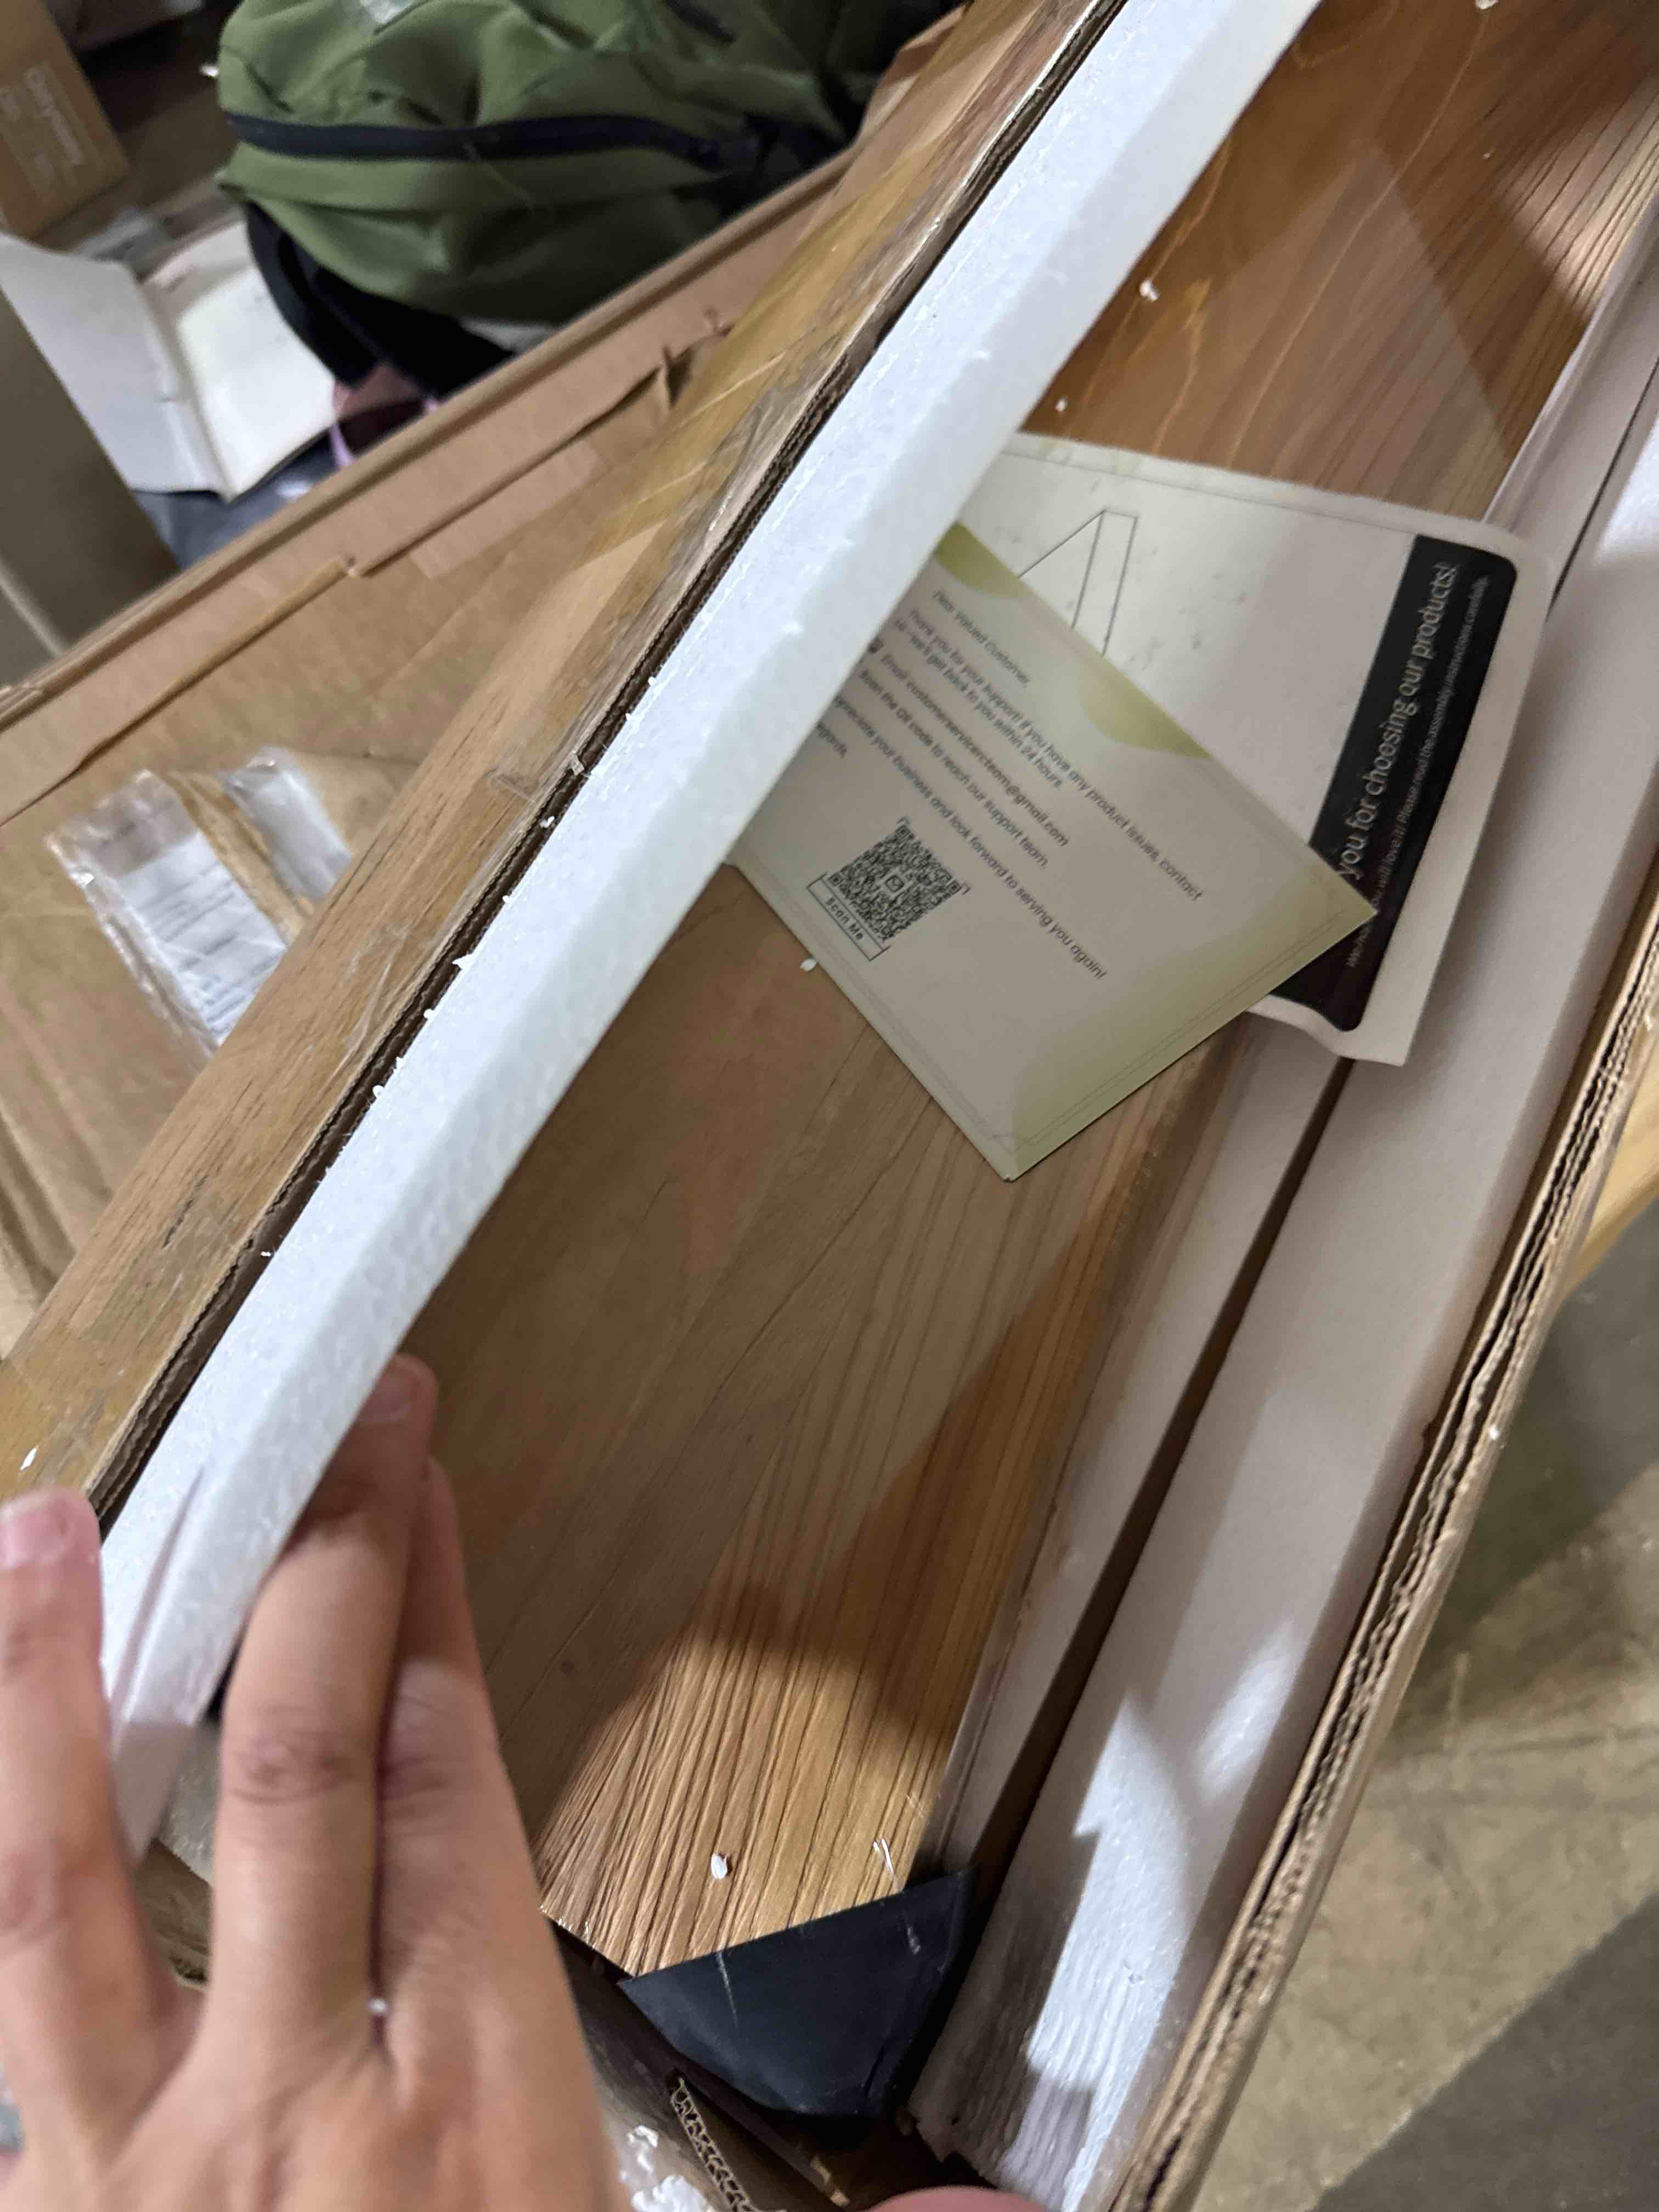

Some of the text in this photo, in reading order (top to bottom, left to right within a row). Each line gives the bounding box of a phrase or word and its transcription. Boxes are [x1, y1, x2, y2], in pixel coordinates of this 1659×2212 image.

[932, 589, 1035, 687] Dear Valued Customer,
[925, 652, 950, 672] get
[942, 667, 971, 692] back
[964, 689, 982, 703] to
[972, 701, 997, 723] you
[1425, 686, 1454, 738] assembly
[992, 717, 1026, 748] within
[1335, 563, 1459, 878] you for choosing our products!
[815, 720, 849, 758] egards,
[906, 608, 939, 636] Thank
[929, 635, 953, 655] you
[947, 650, 968, 666] for
[958, 664, 986, 688] your
[978, 683, 1025, 725] support!
[1022, 729, 1047, 749] you
[1042, 745, 1074, 772] have
[1064, 770, 1090, 793] any
[1083, 788, 1131, 831] product
[1124, 826, 1163, 862] issues,
[1155, 858, 1204, 902] contact
[1019, 745, 1039, 761] 24
[1418, 738, 1435, 758] the
[858, 668, 1052, 870] Scan the QR code to reach our support team.
[1031, 757, 1066, 789] hours.
[1409, 758, 1428, 785] read
[1396, 785, 1419, 823] Please
[831, 693, 1108, 982] ppreciate your business and look forward to serving you again!
[1382, 839, 1401, 864] love
[827, 898, 864, 940] Scan Me
